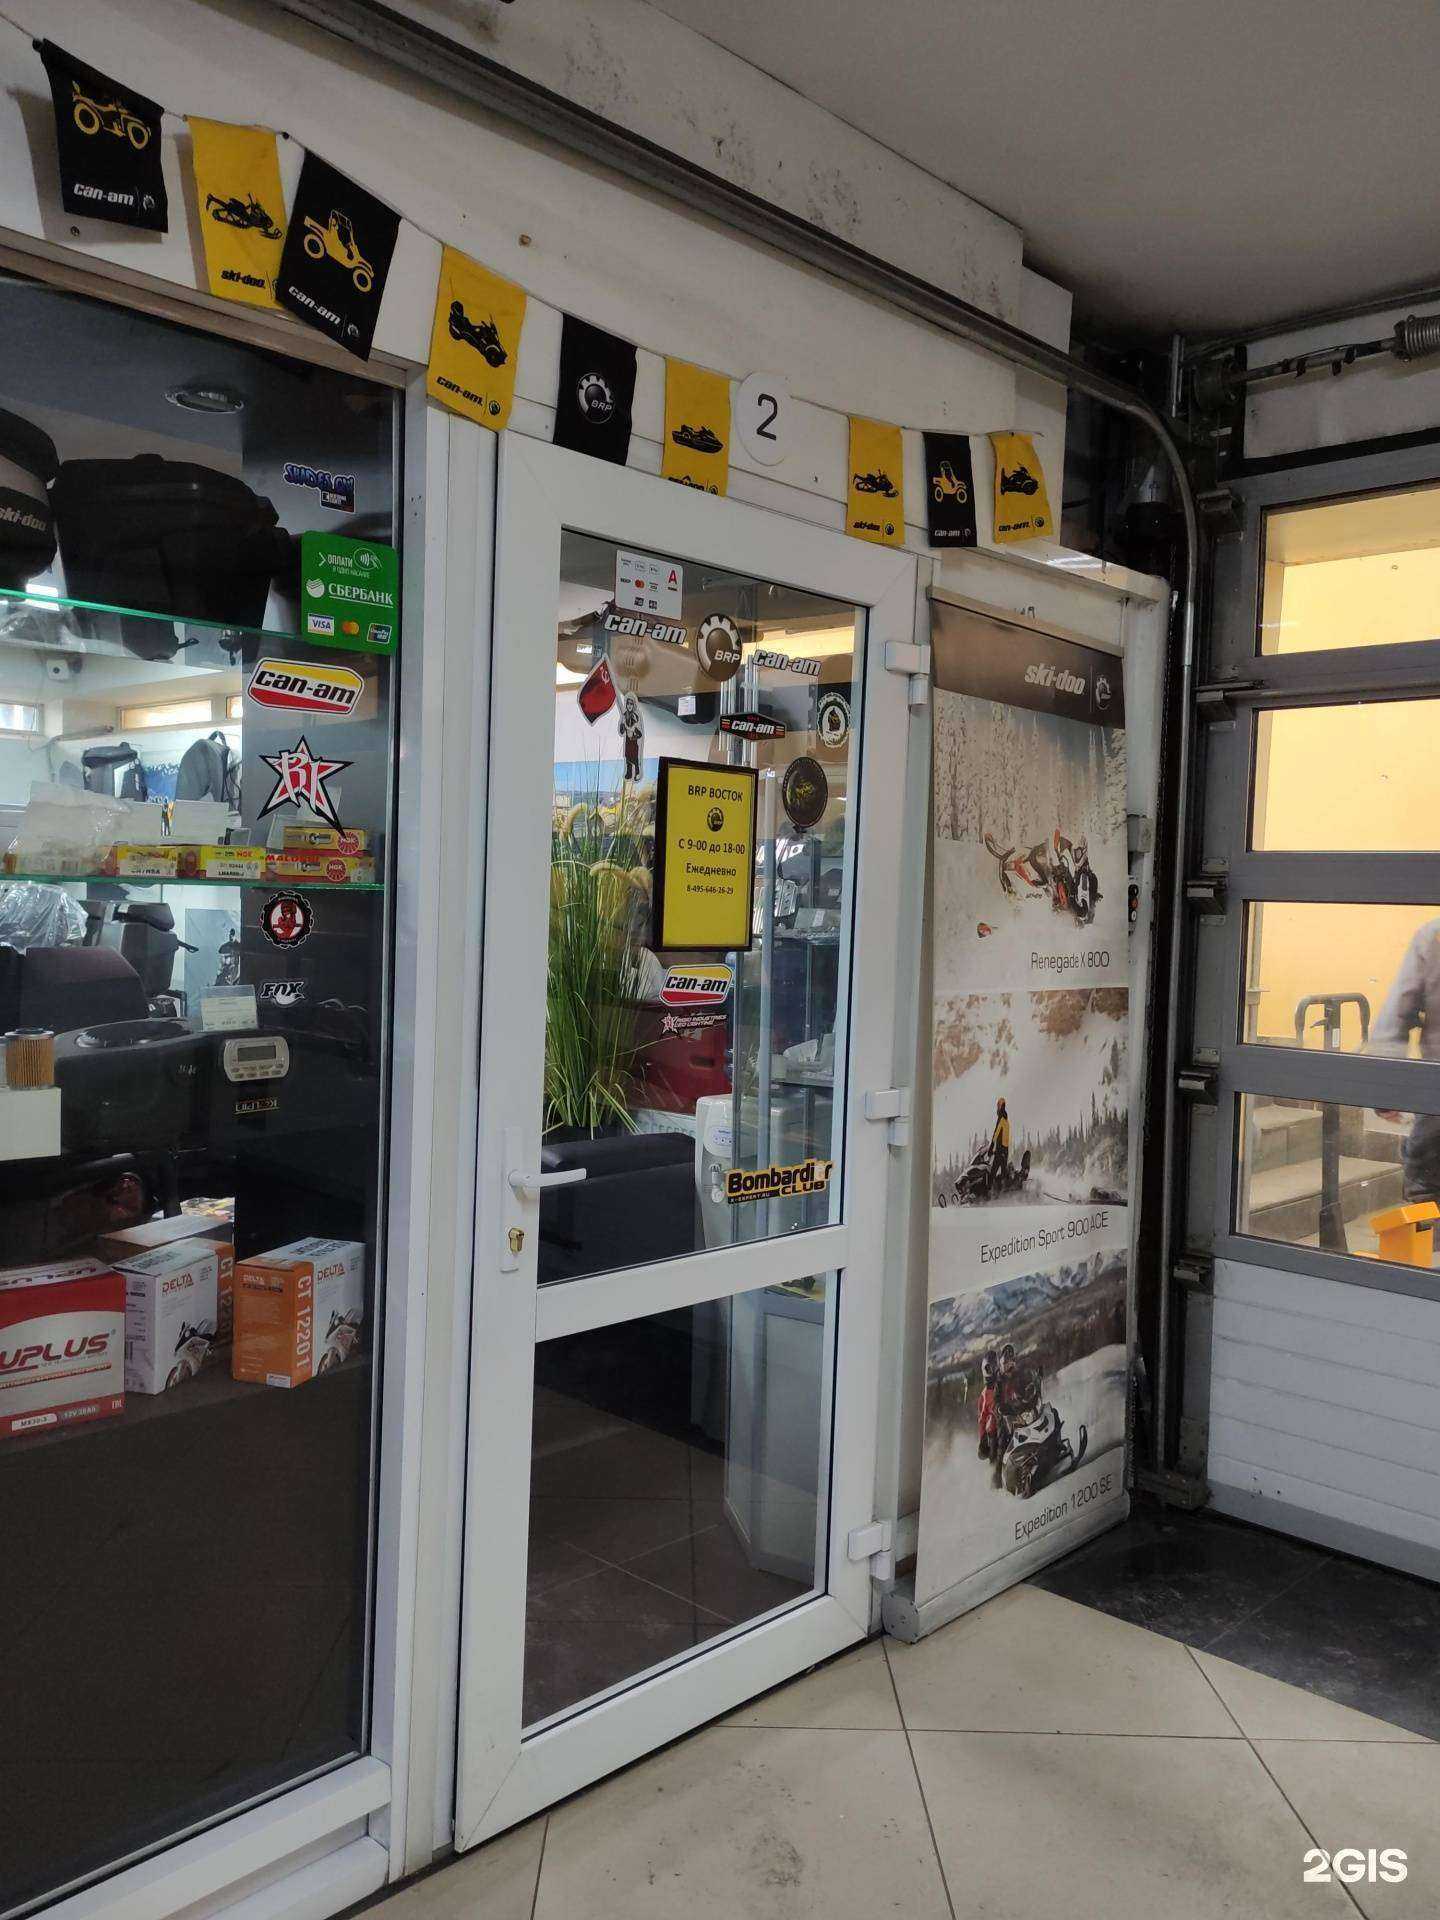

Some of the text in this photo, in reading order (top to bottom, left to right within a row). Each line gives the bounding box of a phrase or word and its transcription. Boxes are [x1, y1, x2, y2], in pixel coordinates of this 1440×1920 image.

[73, 183, 134, 206] can-am
[288, 285, 341, 325] can-am
[591, 400, 613, 412] BRP
[756, 393, 778, 441] 2
[934, 529, 960, 537] can-am
[327, 554, 353, 568] ОПЛАТИ
[328, 582, 394, 606] СБЕРБАНК
[312, 619, 332, 630] VISA
[604, 613, 688, 646] can-am
[714, 649, 741, 664] BRP
[752, 648, 822, 678] can-am
[255, 670, 356, 704] can-am
[1024, 663, 1086, 695] ski-doo
[731, 719, 776, 735] can-am
[688, 784, 744, 802] BRP ВОСТОК
[687, 839, 707, 851] 9-00
[708, 843, 721, 854] до
[723, 842, 746, 855] 18-00
[686, 862, 737, 877] Ежедневно
[1031, 951, 1110, 974] Renegade X 800
[260, 981, 304, 999] FOX
[665, 976, 728, 993] can-am
[727, 1162, 833, 1195] Bombardir
[781, 1180, 825, 1196] CLUB
[980, 1211, 1109, 1264] Expedition Sport 900 ACE
[317, 1262, 345, 1282] DELTA
[161, 1272, 193, 1293] DELTA
[1015, 1473, 1113, 1541] Expedition 1200 SE
